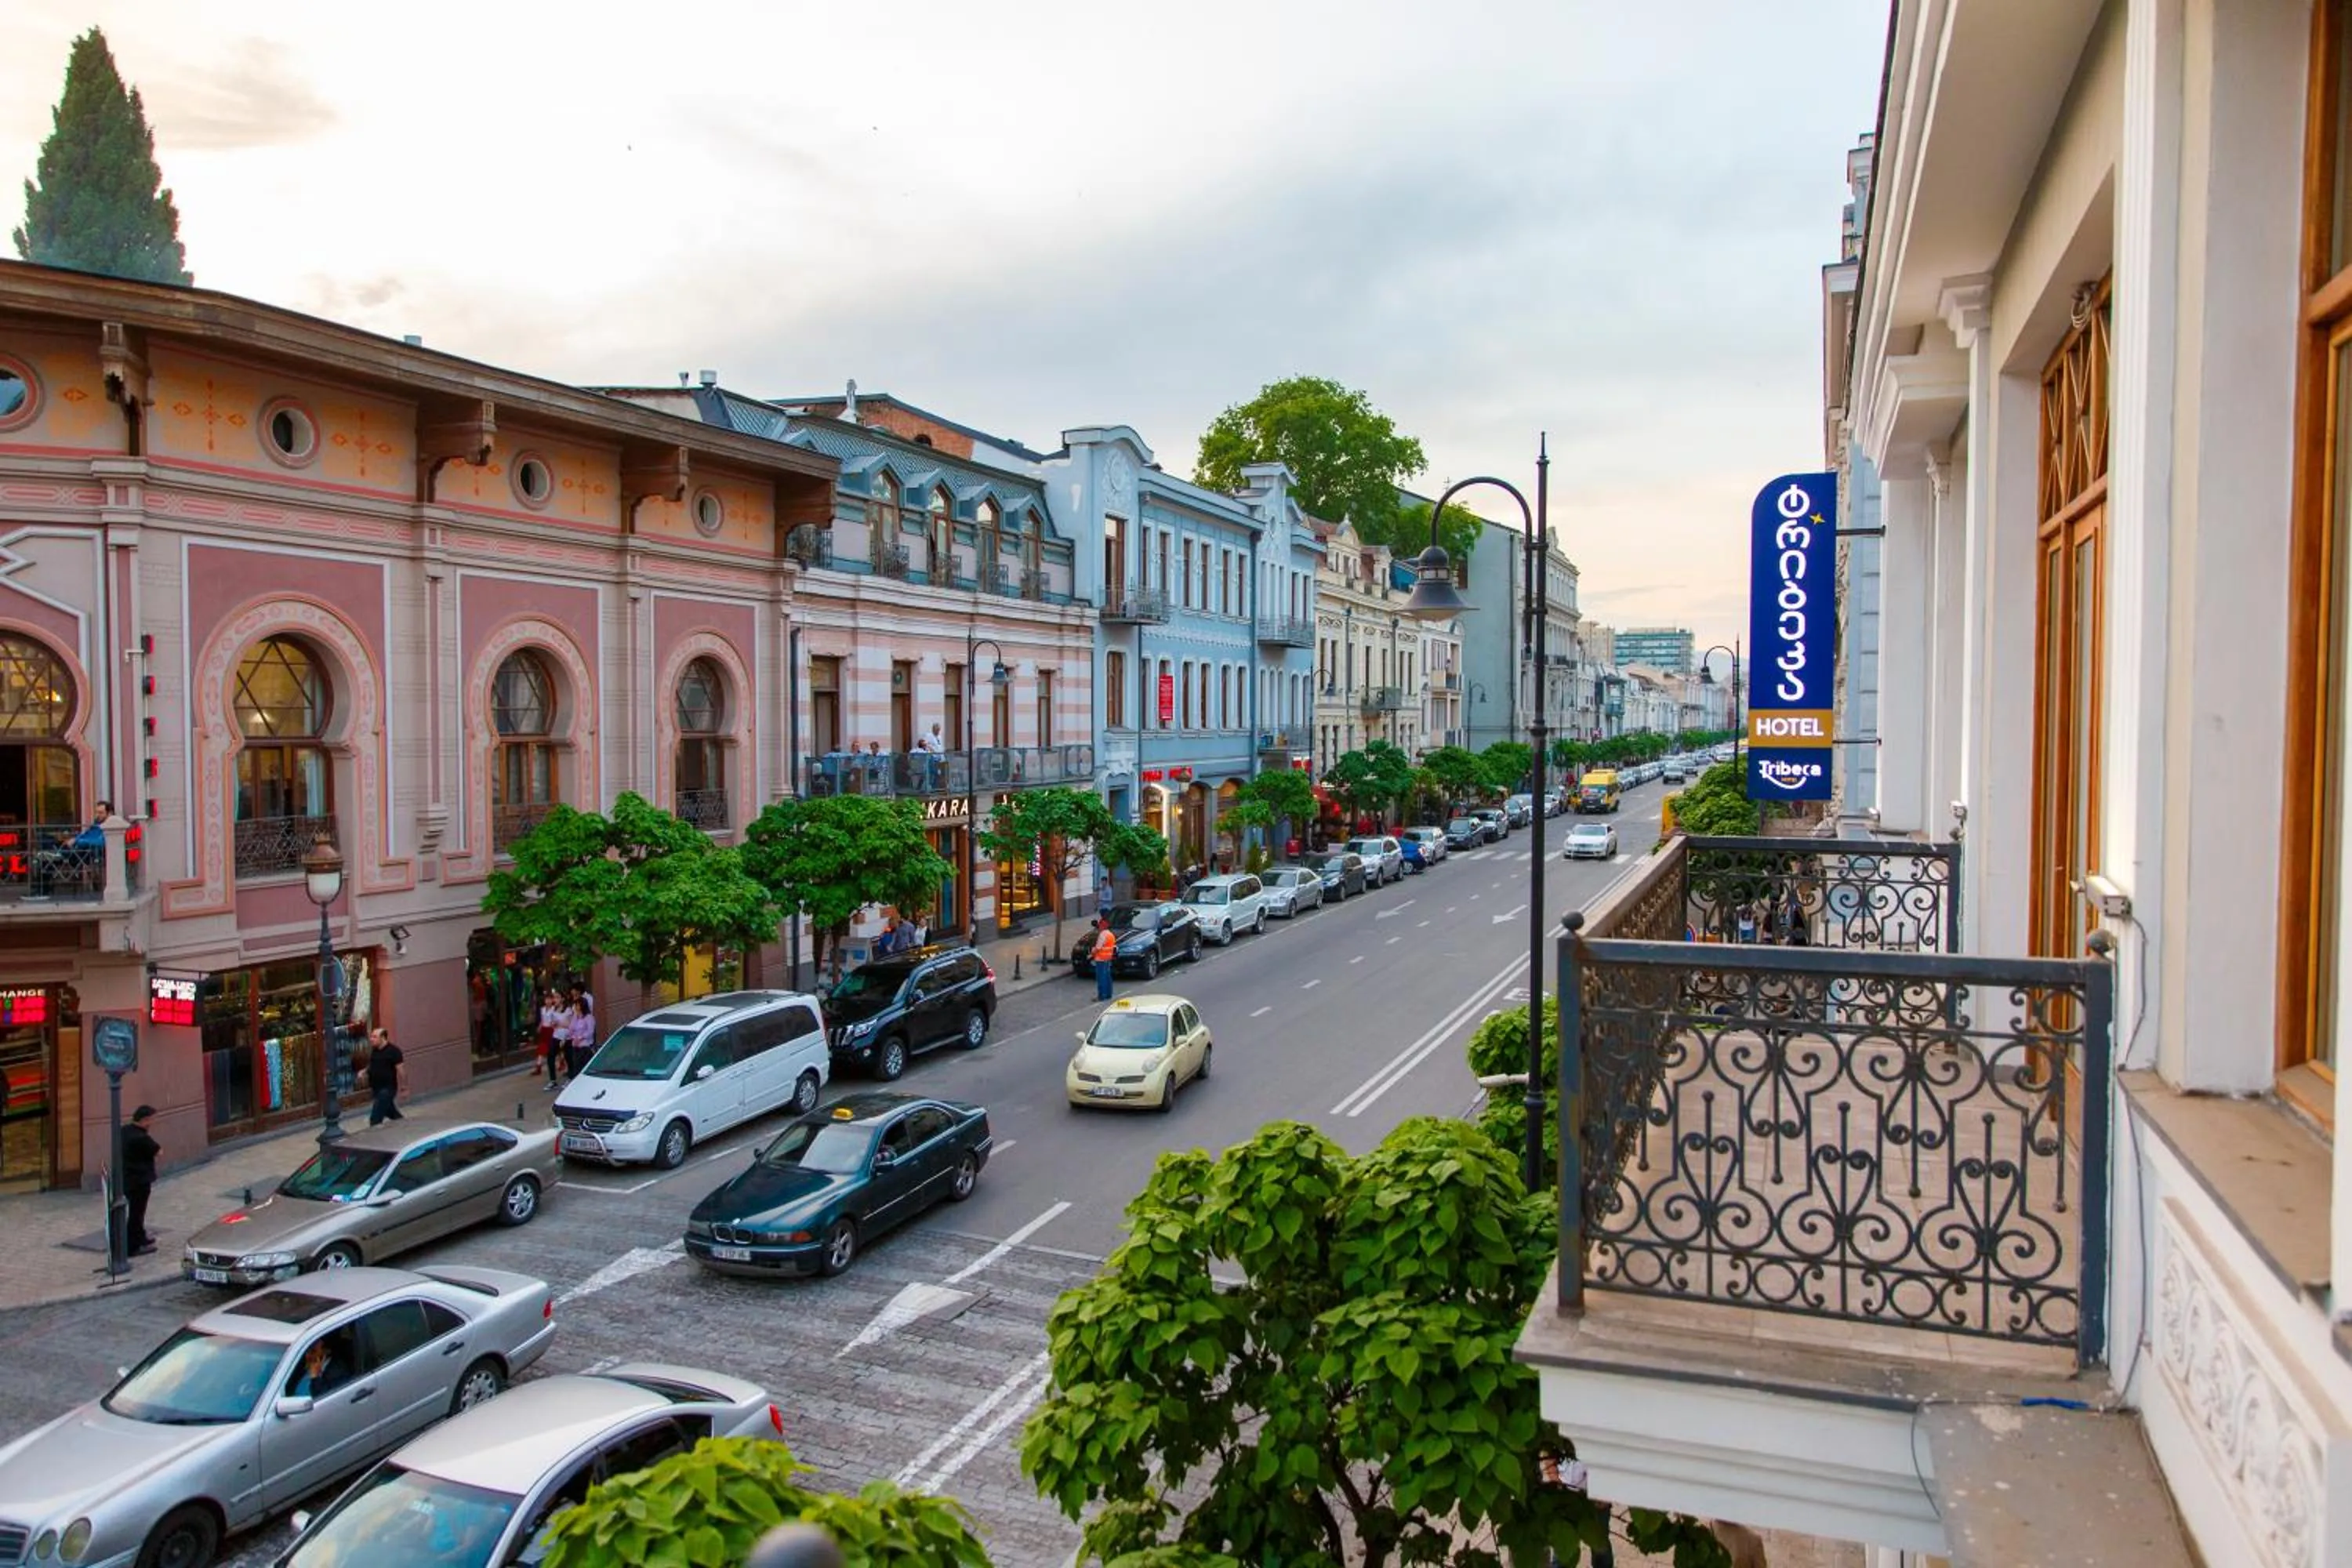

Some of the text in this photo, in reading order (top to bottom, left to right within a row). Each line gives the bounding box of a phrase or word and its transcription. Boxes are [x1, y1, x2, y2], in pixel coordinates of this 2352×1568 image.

[1756, 717, 1825, 736] HOTEL
[1759, 760, 1822, 779] Tribeca
[920, 798, 969, 819] KARA
